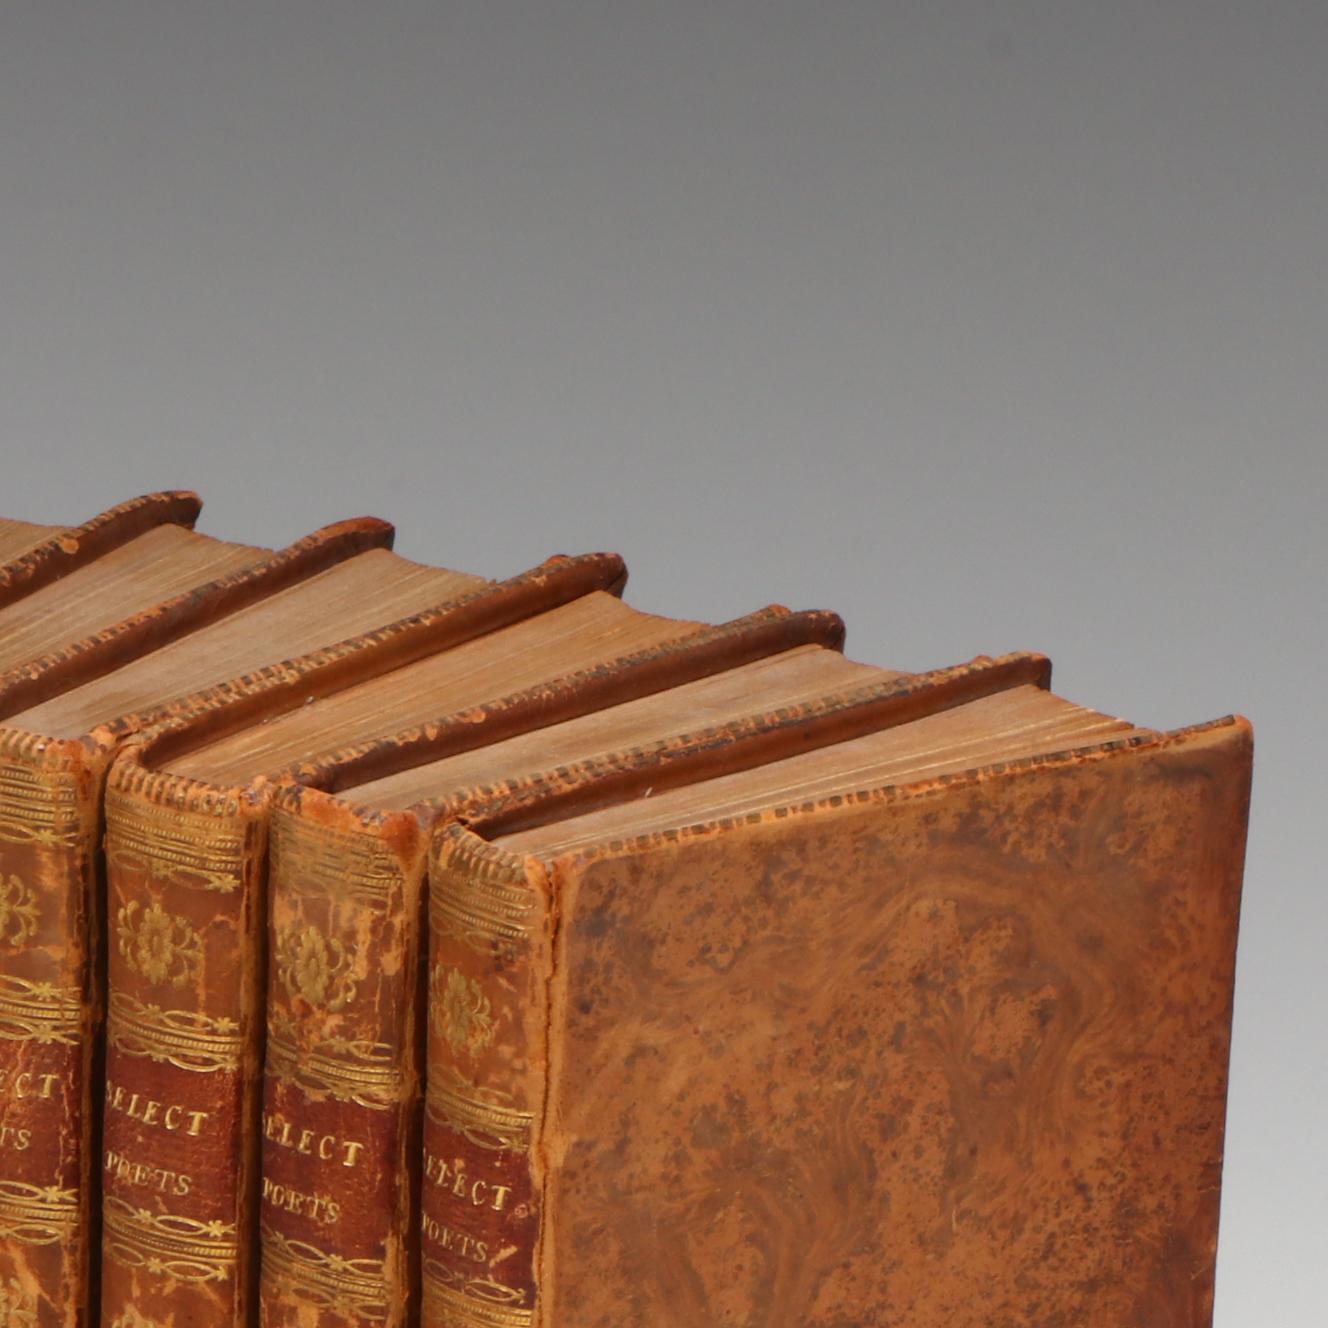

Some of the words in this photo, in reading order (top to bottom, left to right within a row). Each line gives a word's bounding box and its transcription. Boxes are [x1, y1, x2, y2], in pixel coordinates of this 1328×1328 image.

[105, 1150, 194, 1197] POETS
[421, 1146, 513, 1212] ELECT
[262, 1176, 341, 1225] POETS
